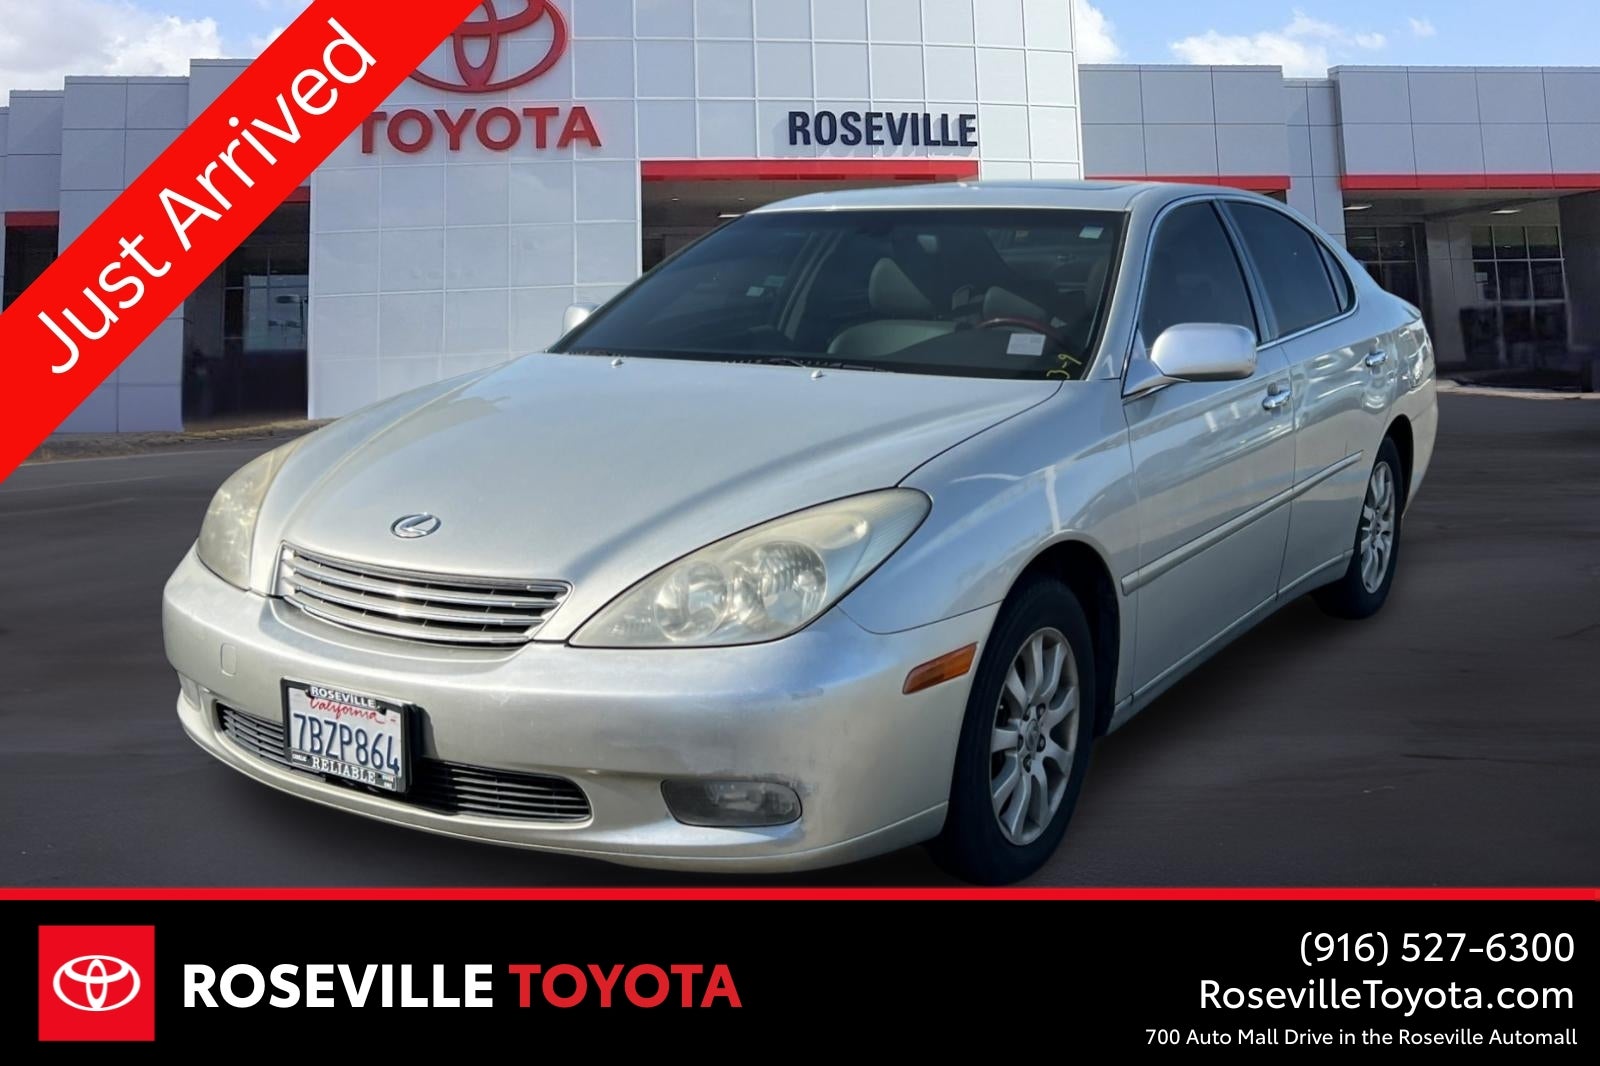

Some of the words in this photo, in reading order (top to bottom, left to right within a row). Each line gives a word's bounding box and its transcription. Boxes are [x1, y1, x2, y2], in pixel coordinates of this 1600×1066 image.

[361, 106, 602, 154] TOYOTA
[788, 110, 978, 147] ROSEVILLE
[308, 697, 385, 724] California
[310, 686, 376, 708] ROSEVILLE
[293, 712, 400, 775] 7BZP864
[311, 756, 376, 784] RELIABLE
